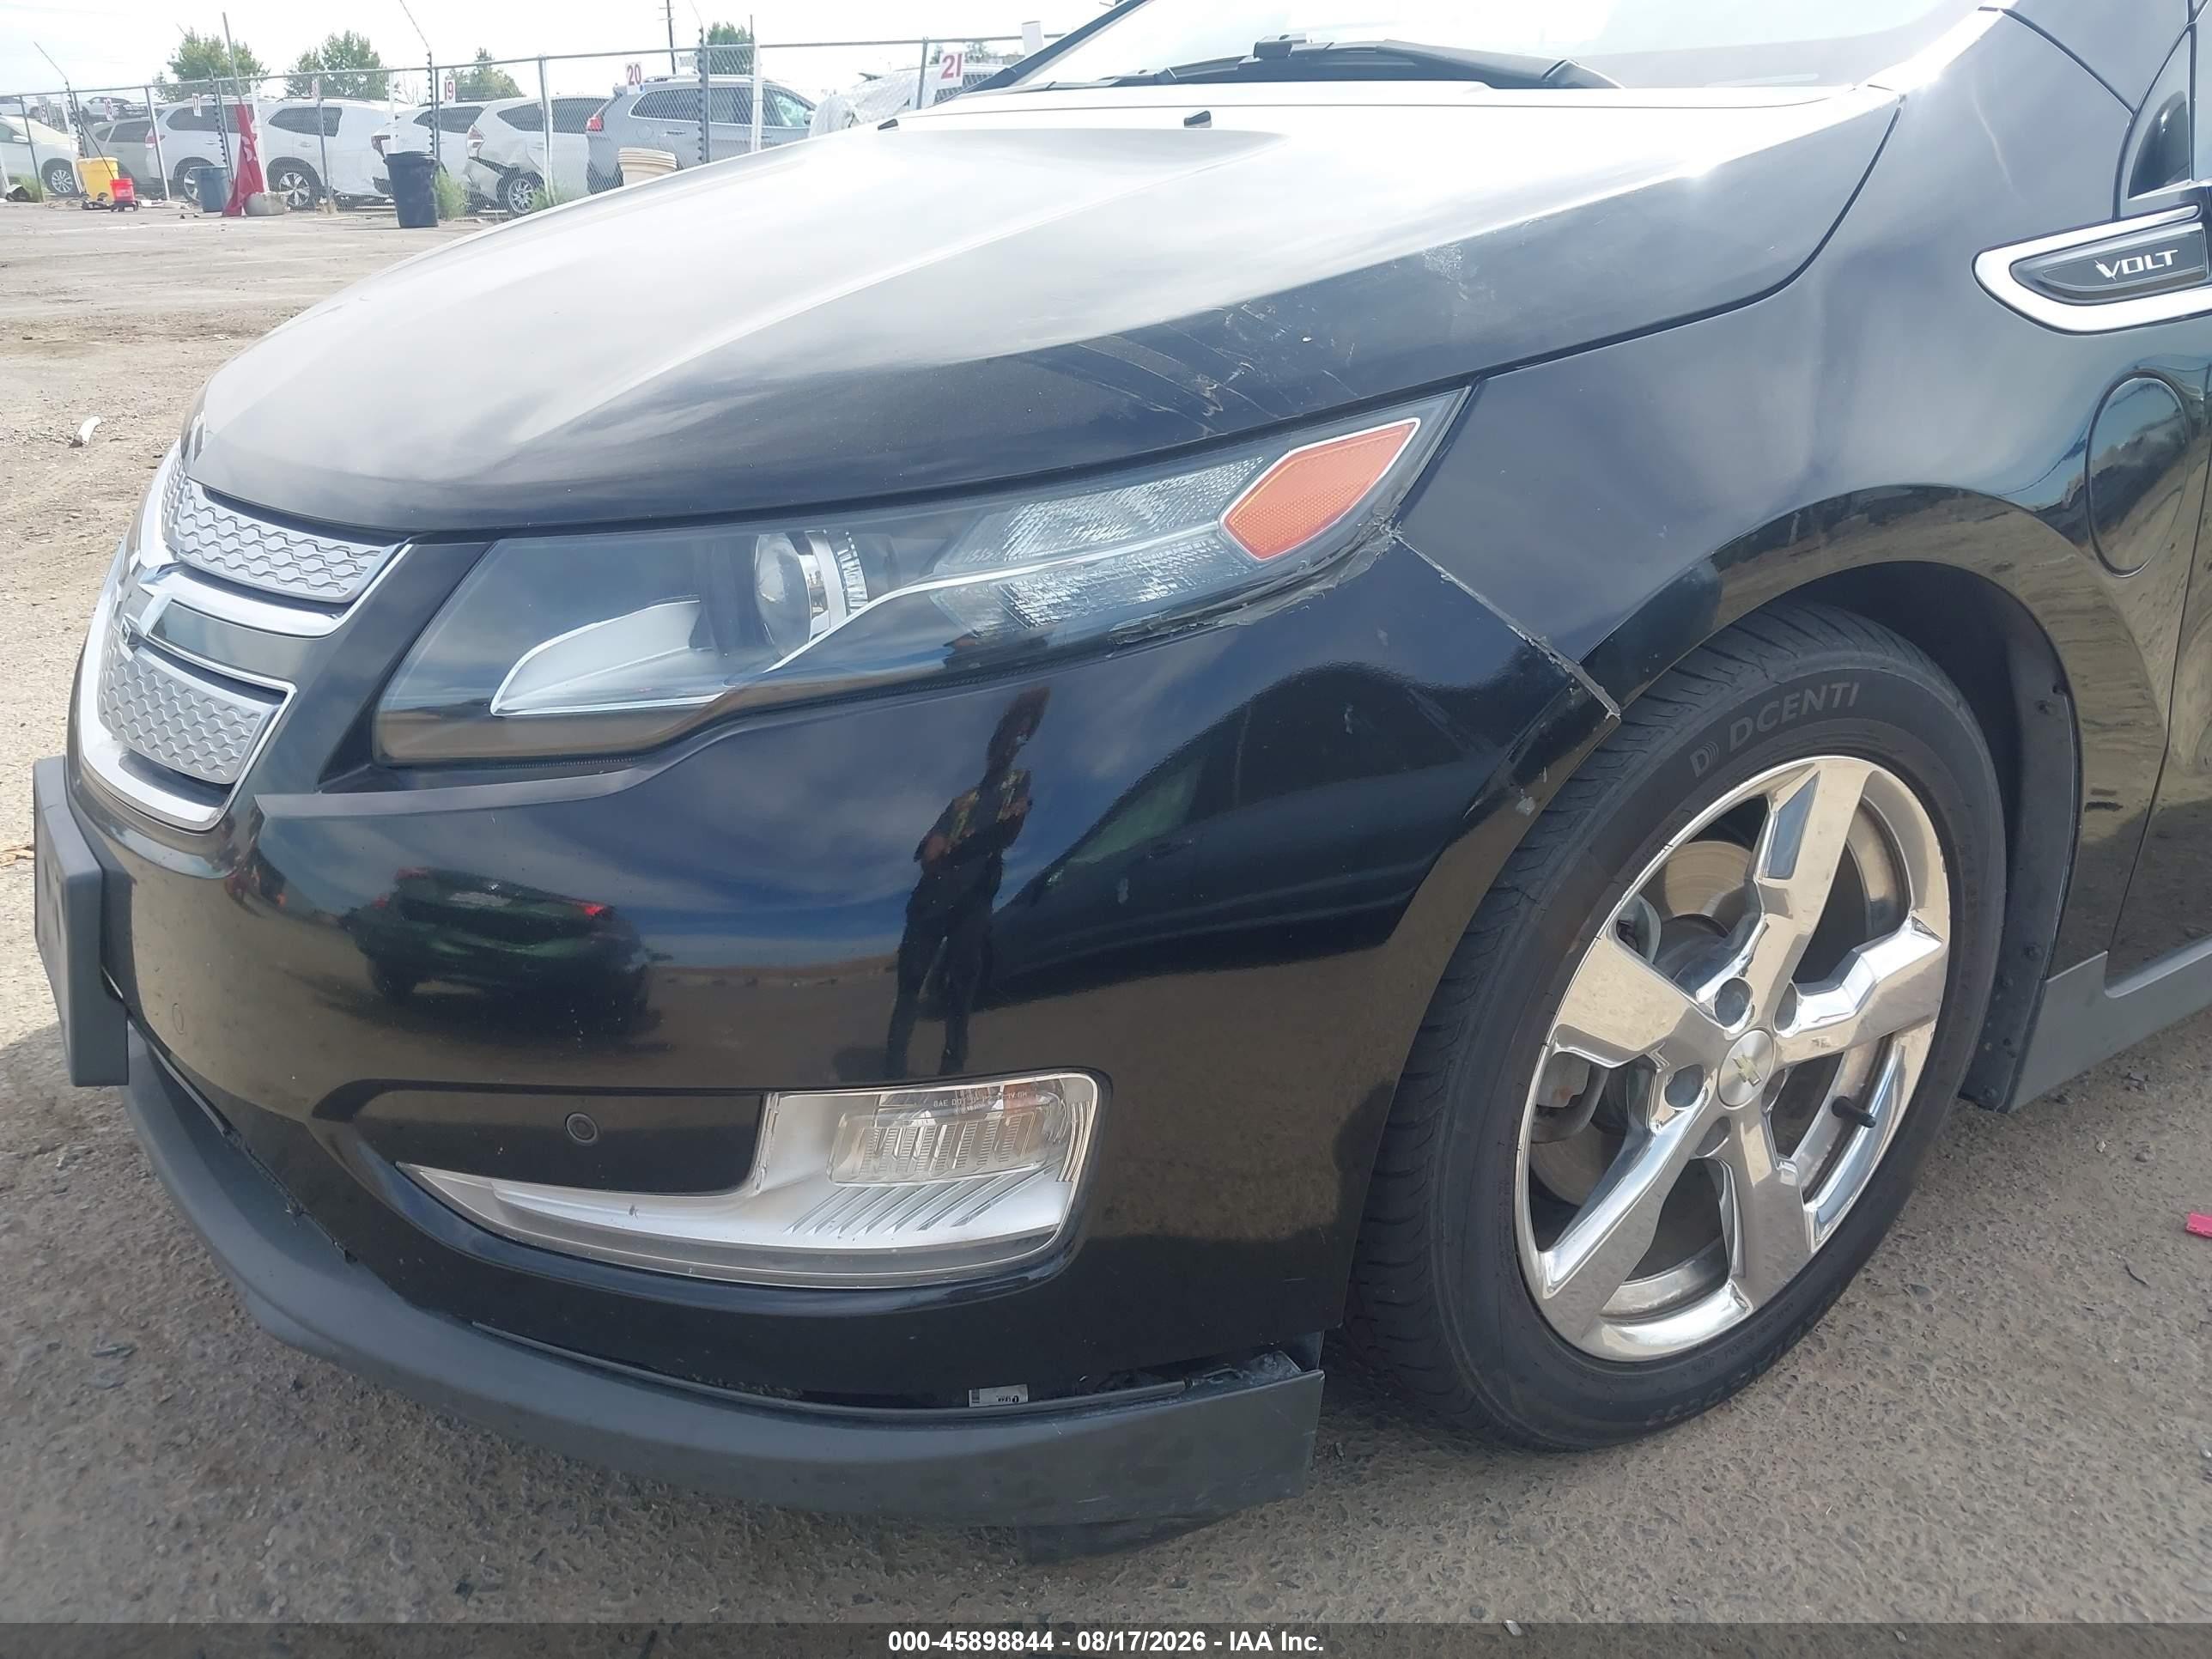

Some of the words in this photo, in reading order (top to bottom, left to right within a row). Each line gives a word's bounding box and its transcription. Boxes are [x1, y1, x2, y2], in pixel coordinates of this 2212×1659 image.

[627, 64, 641, 86] 20
[941, 53, 963, 79] 21
[445, 82, 454, 100] 19
[105, 100, 113, 116] 16
[2095, 250, 2179, 281] VOLT
[1729, 682, 1861, 752] DCENTI
